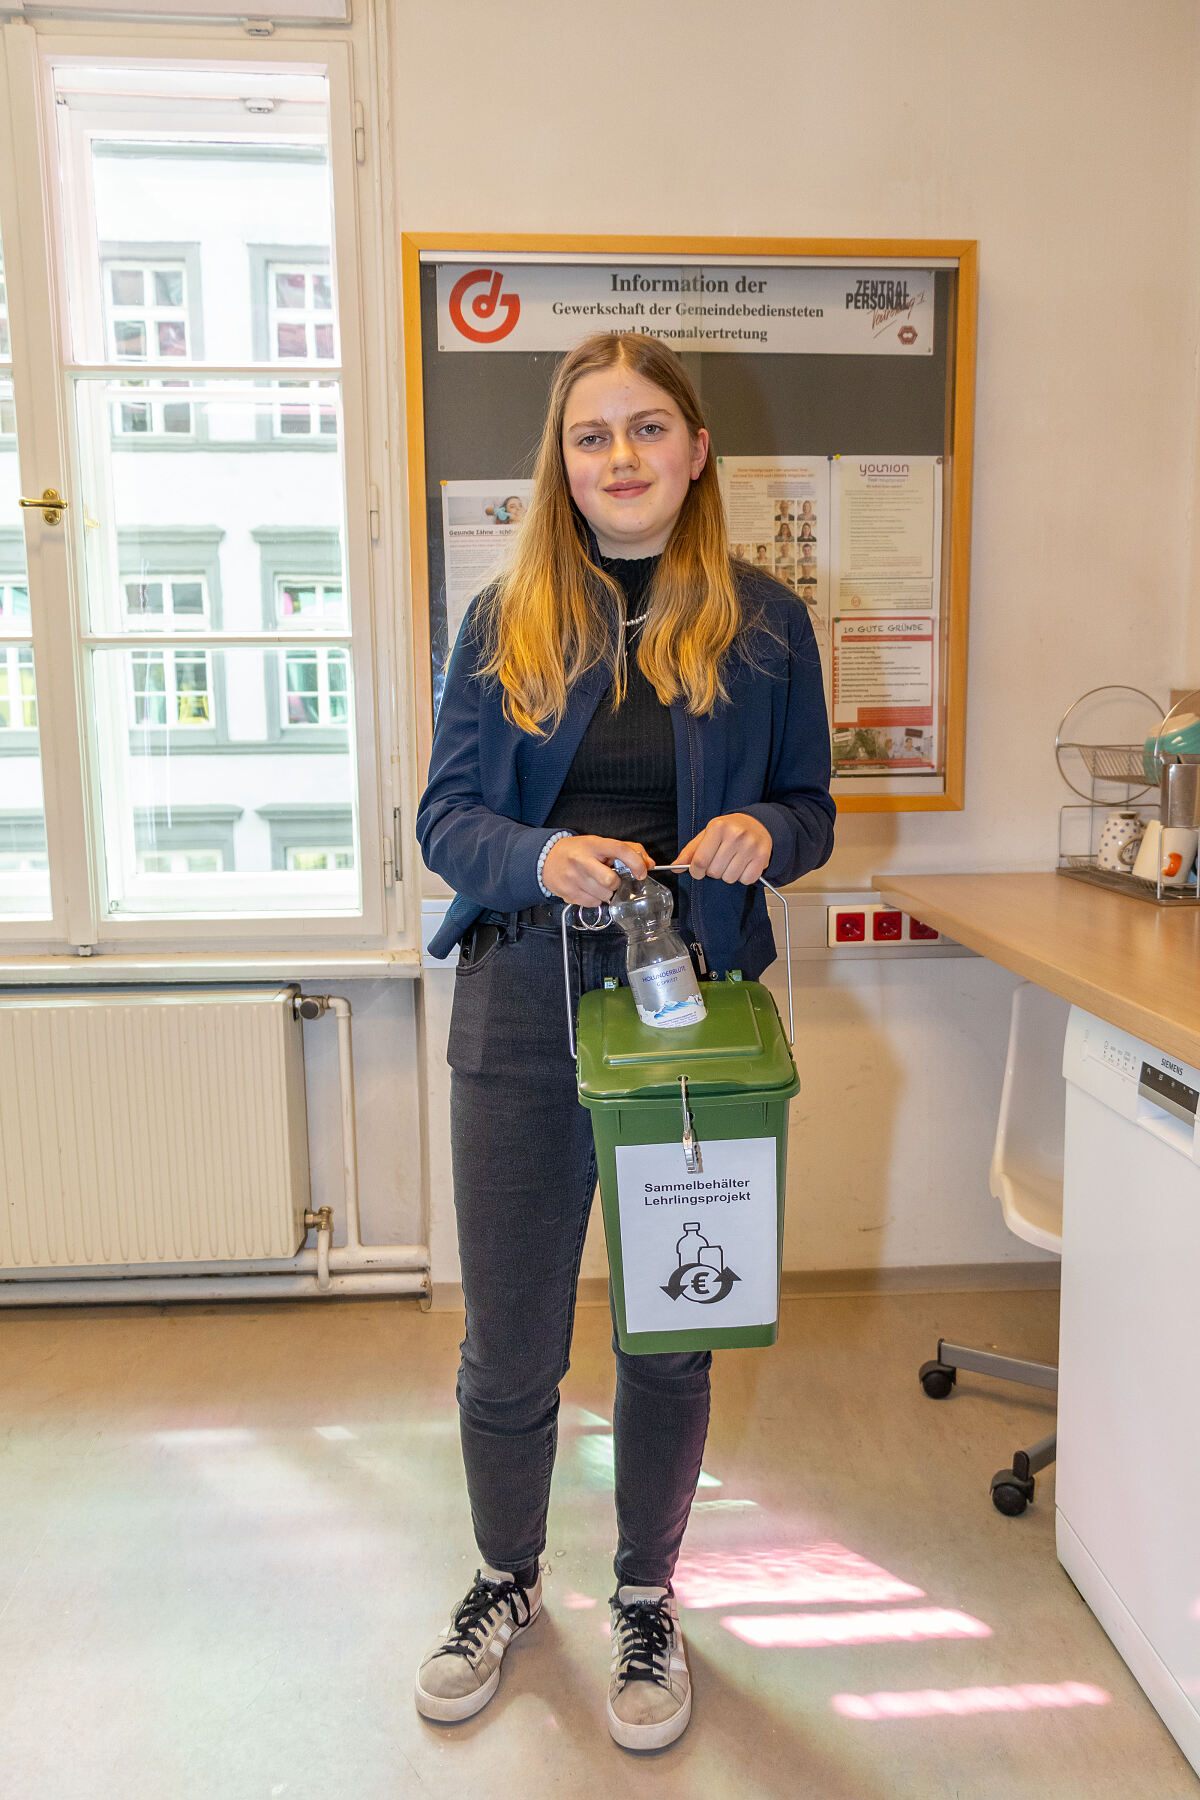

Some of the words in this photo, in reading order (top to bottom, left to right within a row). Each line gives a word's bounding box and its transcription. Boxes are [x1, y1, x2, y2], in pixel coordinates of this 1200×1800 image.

[611, 274, 728, 293] Information
[735, 275, 767, 293] der
[856, 280, 909, 297] ZENTRAL
[846, 293, 909, 310] PERSONAL
[552, 302, 645, 315] Gewerkschaft
[649, 303, 671, 316] der
[676, 303, 824, 318] Gemeindebediensteten
[641, 326, 768, 342] Personalvertretung
[859, 464, 909, 477] younion
[857, 625, 883, 633] GUTE
[1161, 1058, 1183, 1076] SIEMENS
[644, 1179, 750, 1193] Sammelbehälter
[644, 1191, 751, 1206] Lehrlingsprojekt
